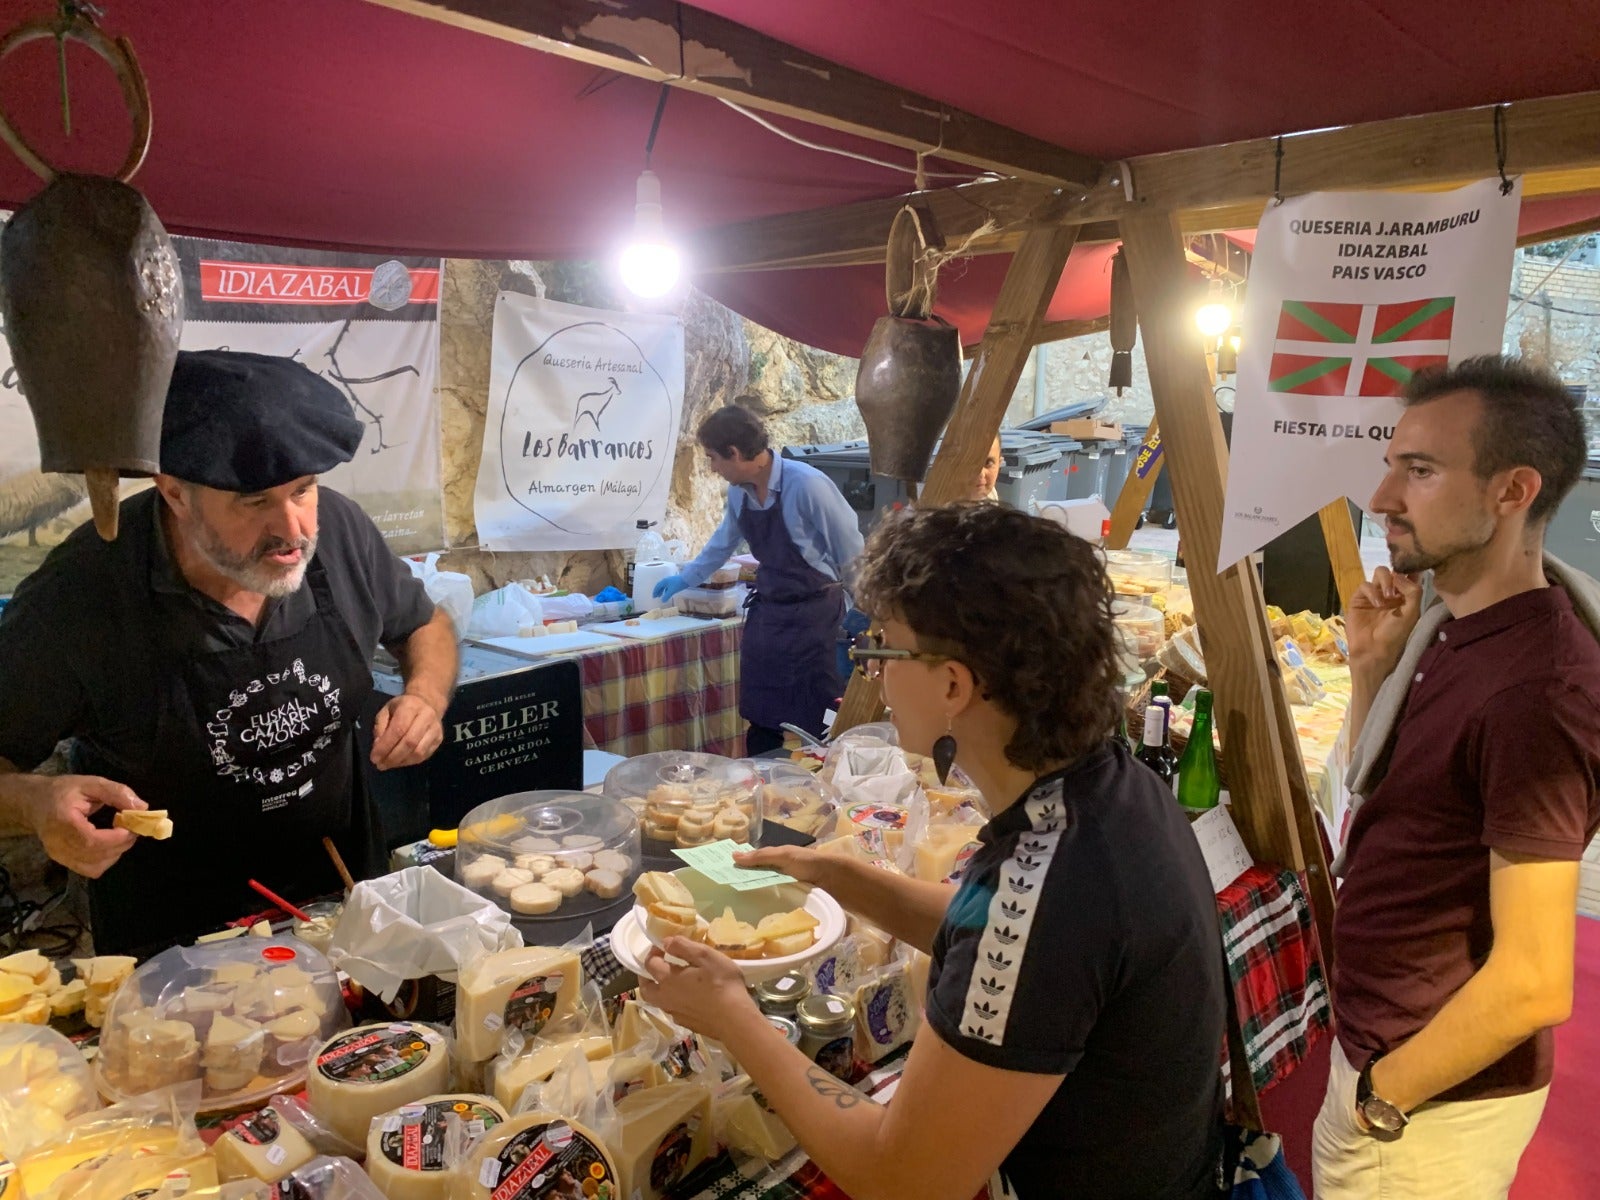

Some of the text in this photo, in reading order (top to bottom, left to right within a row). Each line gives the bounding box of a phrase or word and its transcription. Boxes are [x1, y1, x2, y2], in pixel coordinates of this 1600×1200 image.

[1289, 209, 1480, 237] QUESERIA J.ARAMBURU
[1338, 243, 1429, 259] IDIAZABAL
[218, 269, 368, 298] IDIAZABAL
[1332, 264, 1426, 280] PAIS VASCO
[594, 357, 643, 374] Artesanal
[1273, 420, 1396, 442] FIESTA DEL QU
[522, 431, 653, 461] Los Barrancos
[528, 479, 642, 496] Almargen (Málaga)
[250, 698, 305, 729] EUSKAL
[452, 700, 560, 743] KELER
[256, 721, 311, 751] AZOKA
[466, 729, 525, 750] DONOSTIA
[464, 737, 552, 767] GARAGARDOA
[479, 752, 539, 775] CERVEZA
[493, 1148, 550, 1200] IDIAZABAL
